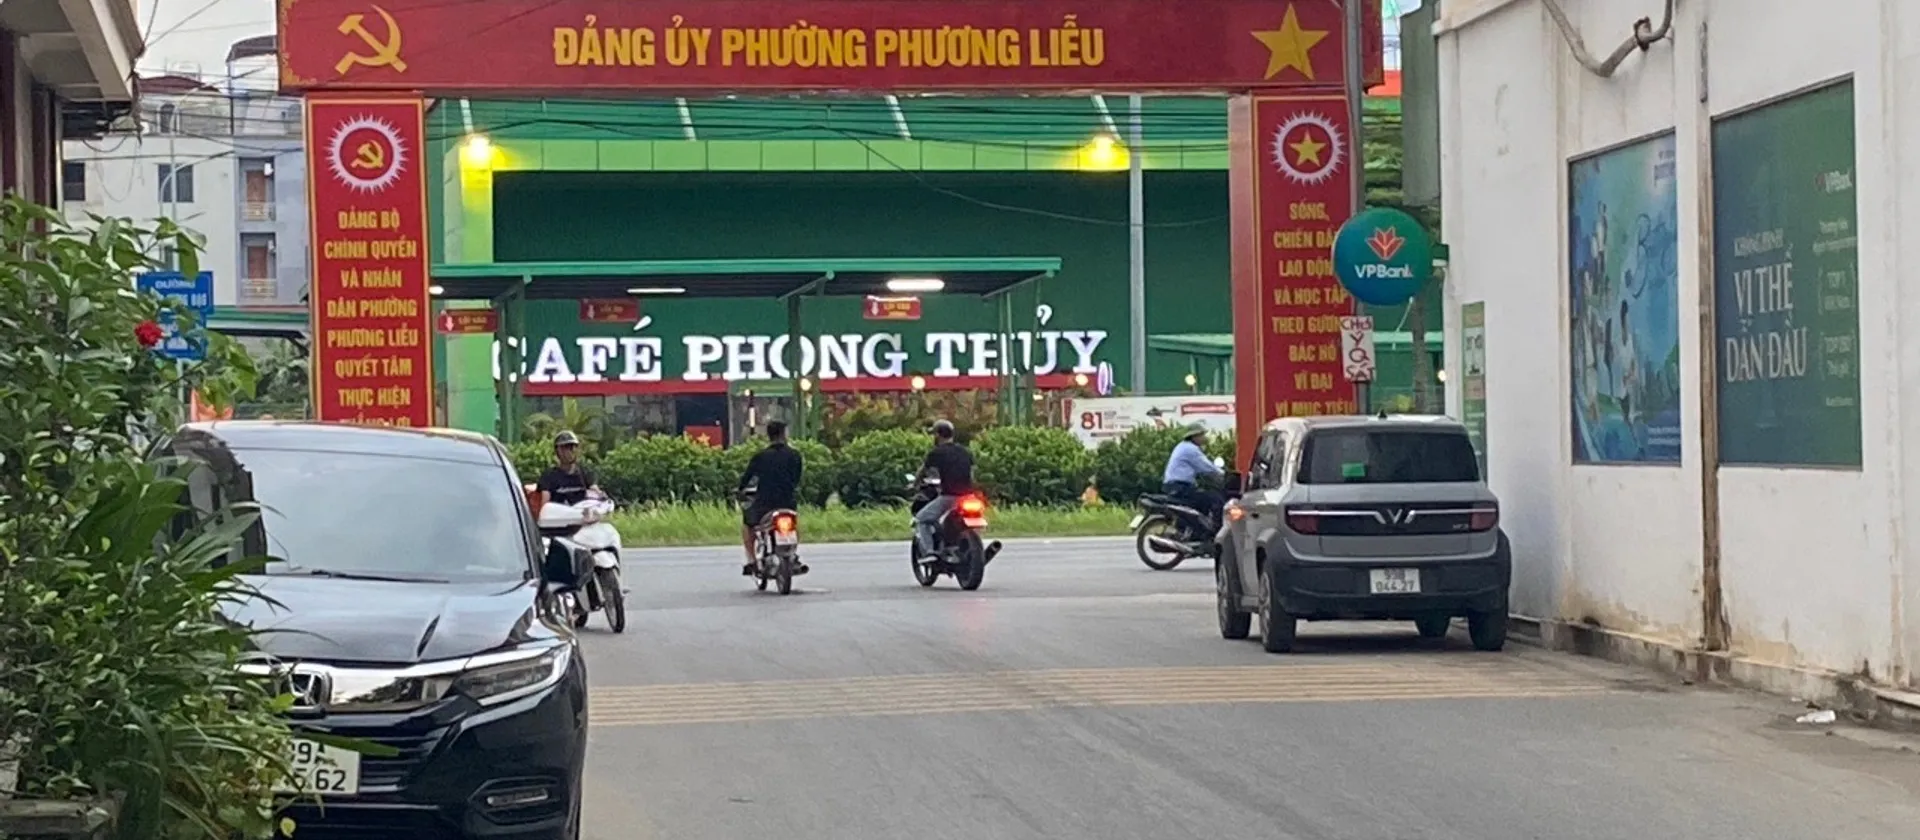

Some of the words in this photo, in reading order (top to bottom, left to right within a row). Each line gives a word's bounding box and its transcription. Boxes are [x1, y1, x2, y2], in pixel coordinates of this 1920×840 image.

[553, 15, 655, 66] ĐẢNG
[665, 15, 711, 66] ỦY
[722, 20, 867, 67] PHƯỜNG
[876, 26, 1020, 67] PHƯƠNG
[1030, 14, 1104, 66] LIỄU
[338, 205, 378, 229] ĐẢNG
[381, 206, 400, 232] BỘ
[324, 239, 368, 259] CHÍNH
[371, 235, 417, 260] QUYỀN
[341, 267, 358, 288] VÀ
[363, 267, 402, 288] NHÂN
[1279, 259, 1303, 277] LAO
[1354, 264, 1413, 278] VPBank
[1755, 243, 1793, 314] THẾ
[327, 296, 356, 318] DÂN
[360, 294, 417, 318] PHƯỜNG
[1274, 285, 1292, 305] VÀ
[327, 328, 384, 348] PHƯƠNG
[388, 323, 418, 346] LIỄU
[1272, 316, 1304, 334] THEO
[683, 334, 908, 380] PHONG
[926, 304, 1108, 378] THỦY
[1289, 340, 1316, 362] BÁC
[1319, 339, 1337, 362] HỒ
[1768, 311, 1807, 379] ĐẦU
[335, 353, 378, 378] QUYẾT
[382, 355, 412, 376] TÂM
[1311, 371, 1333, 392] ĐẠI
[338, 388, 374, 409] THỰC
[378, 385, 411, 409] HIỆN
[1081, 411, 1102, 430] 81
